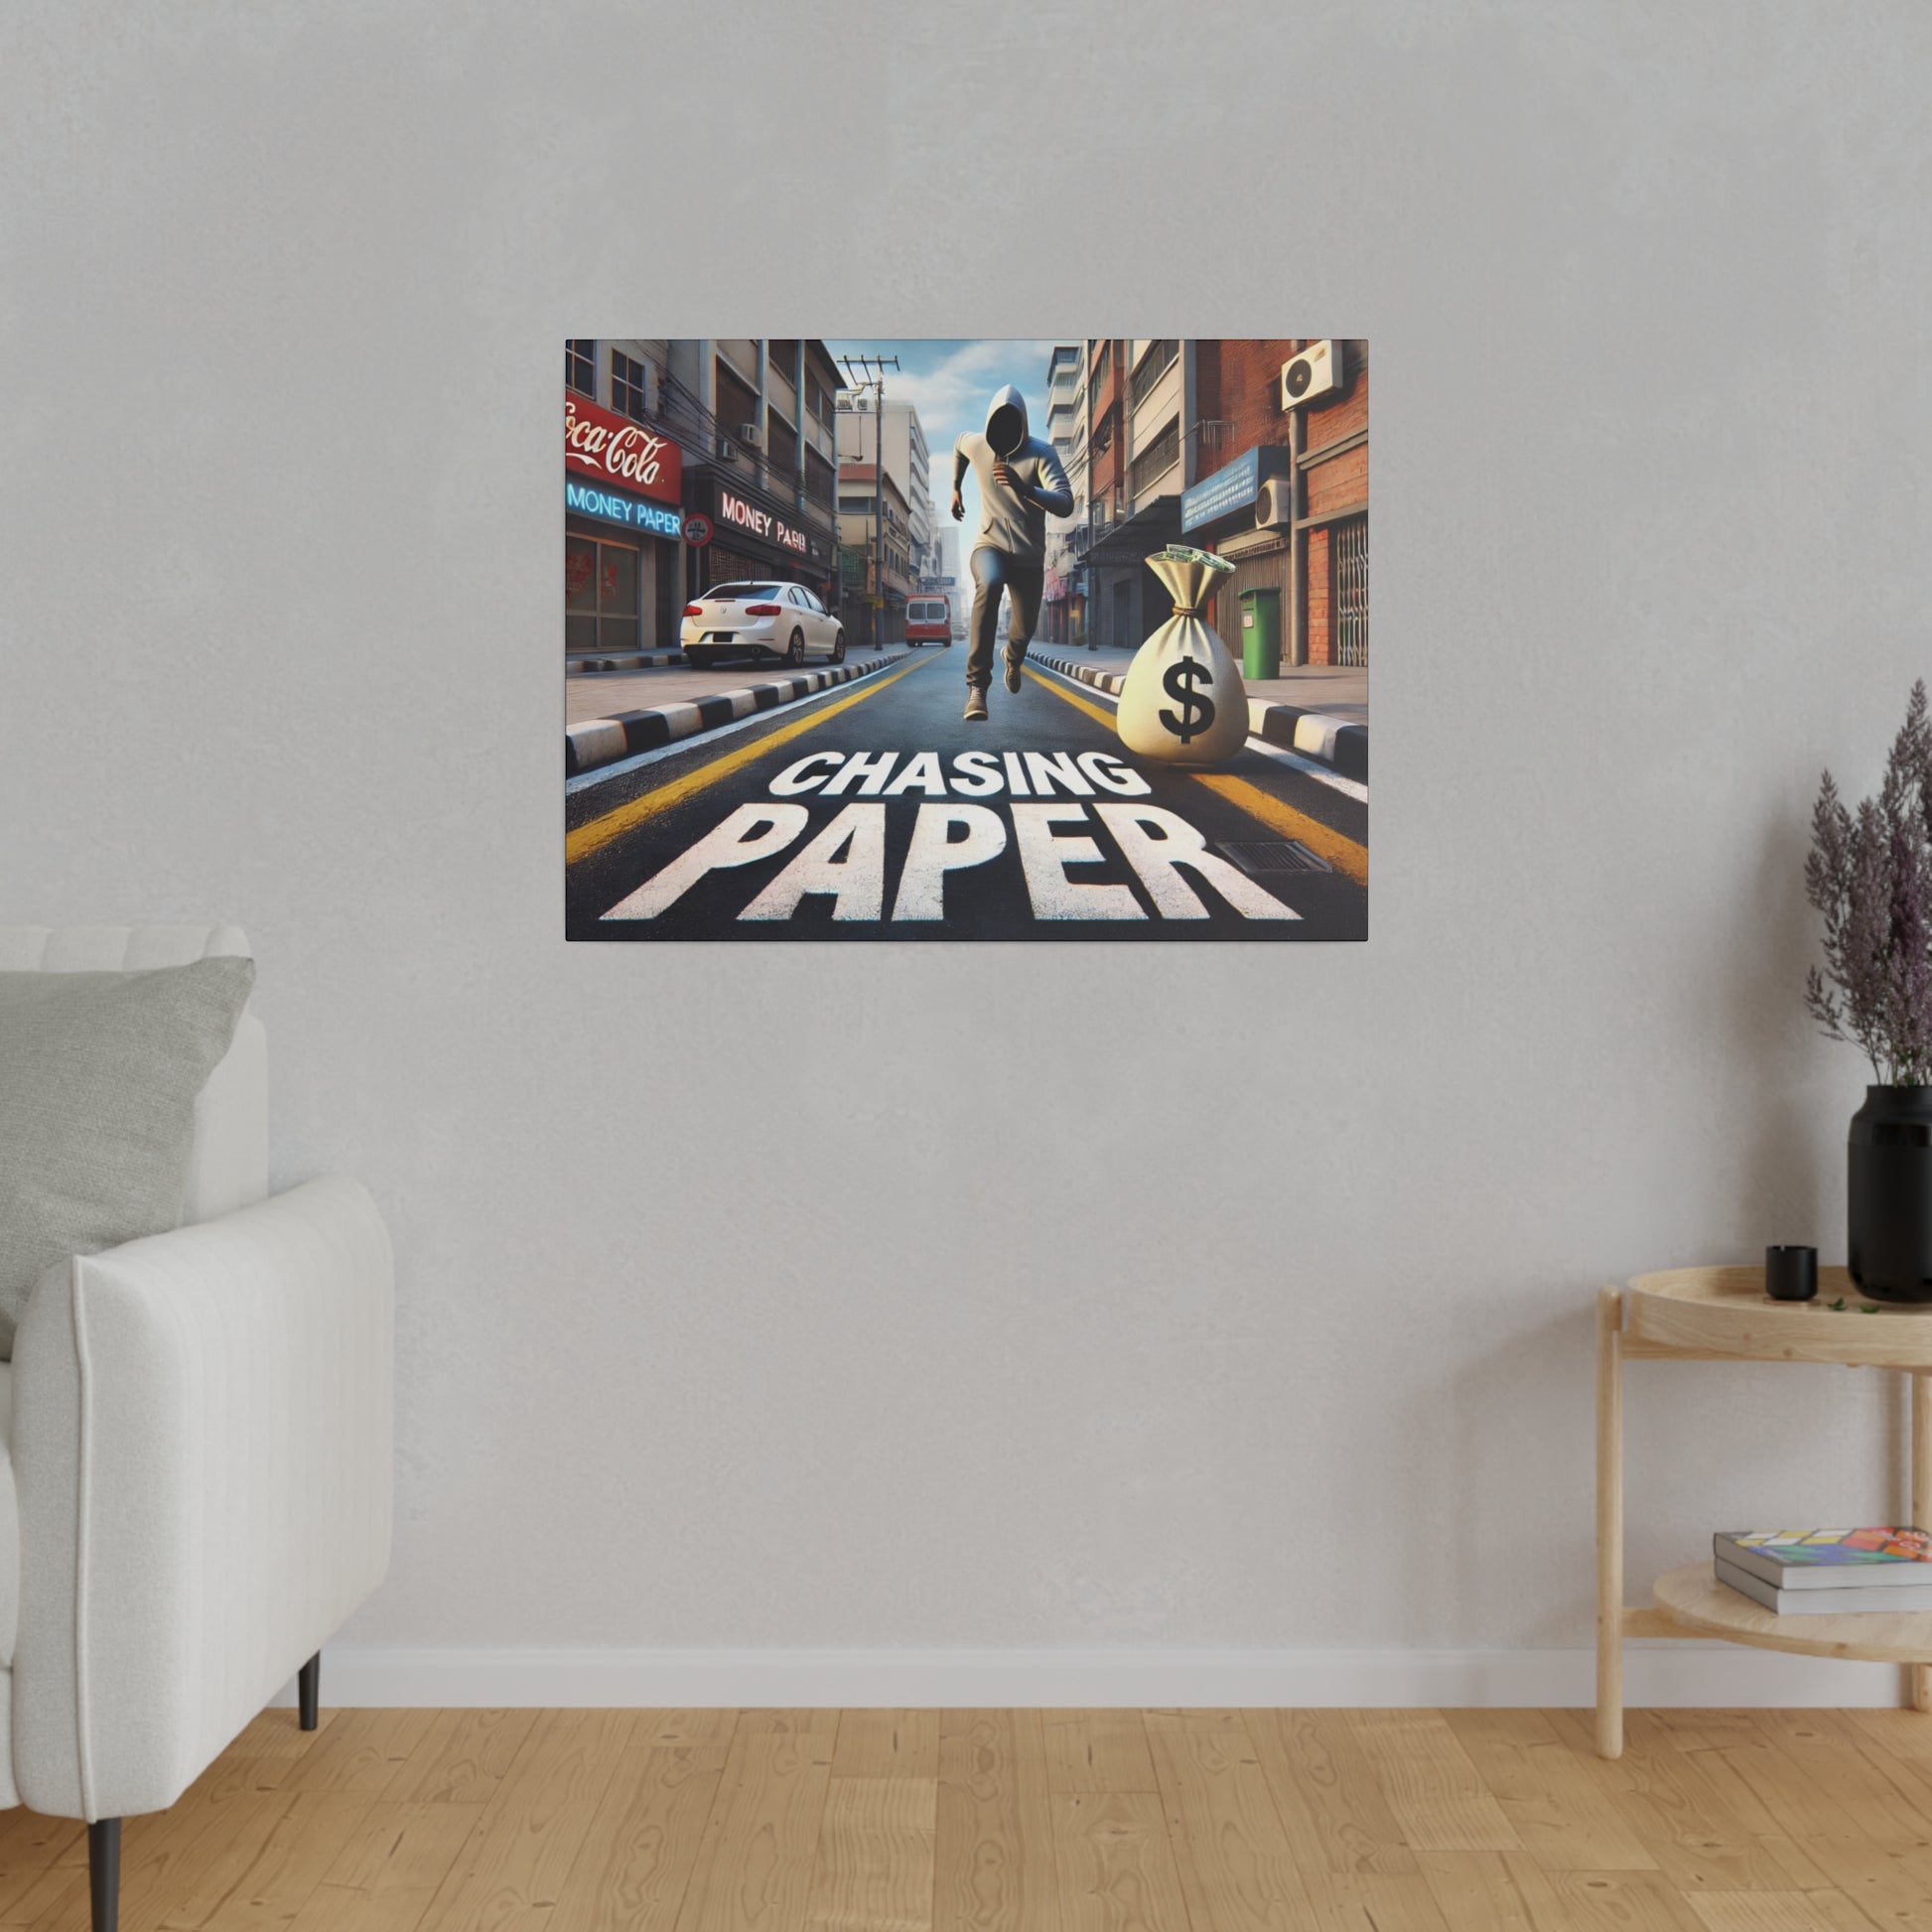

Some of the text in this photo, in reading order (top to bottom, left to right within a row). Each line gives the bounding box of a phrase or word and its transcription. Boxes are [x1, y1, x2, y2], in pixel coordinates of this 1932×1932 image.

[567, 483, 681, 536] MONEY PAPER
[722, 491, 771, 537] MONEY
[1159, 655, 1216, 745] $
[768, 751, 1153, 797] CHASING
[599, 802, 1304, 921] PAPER
